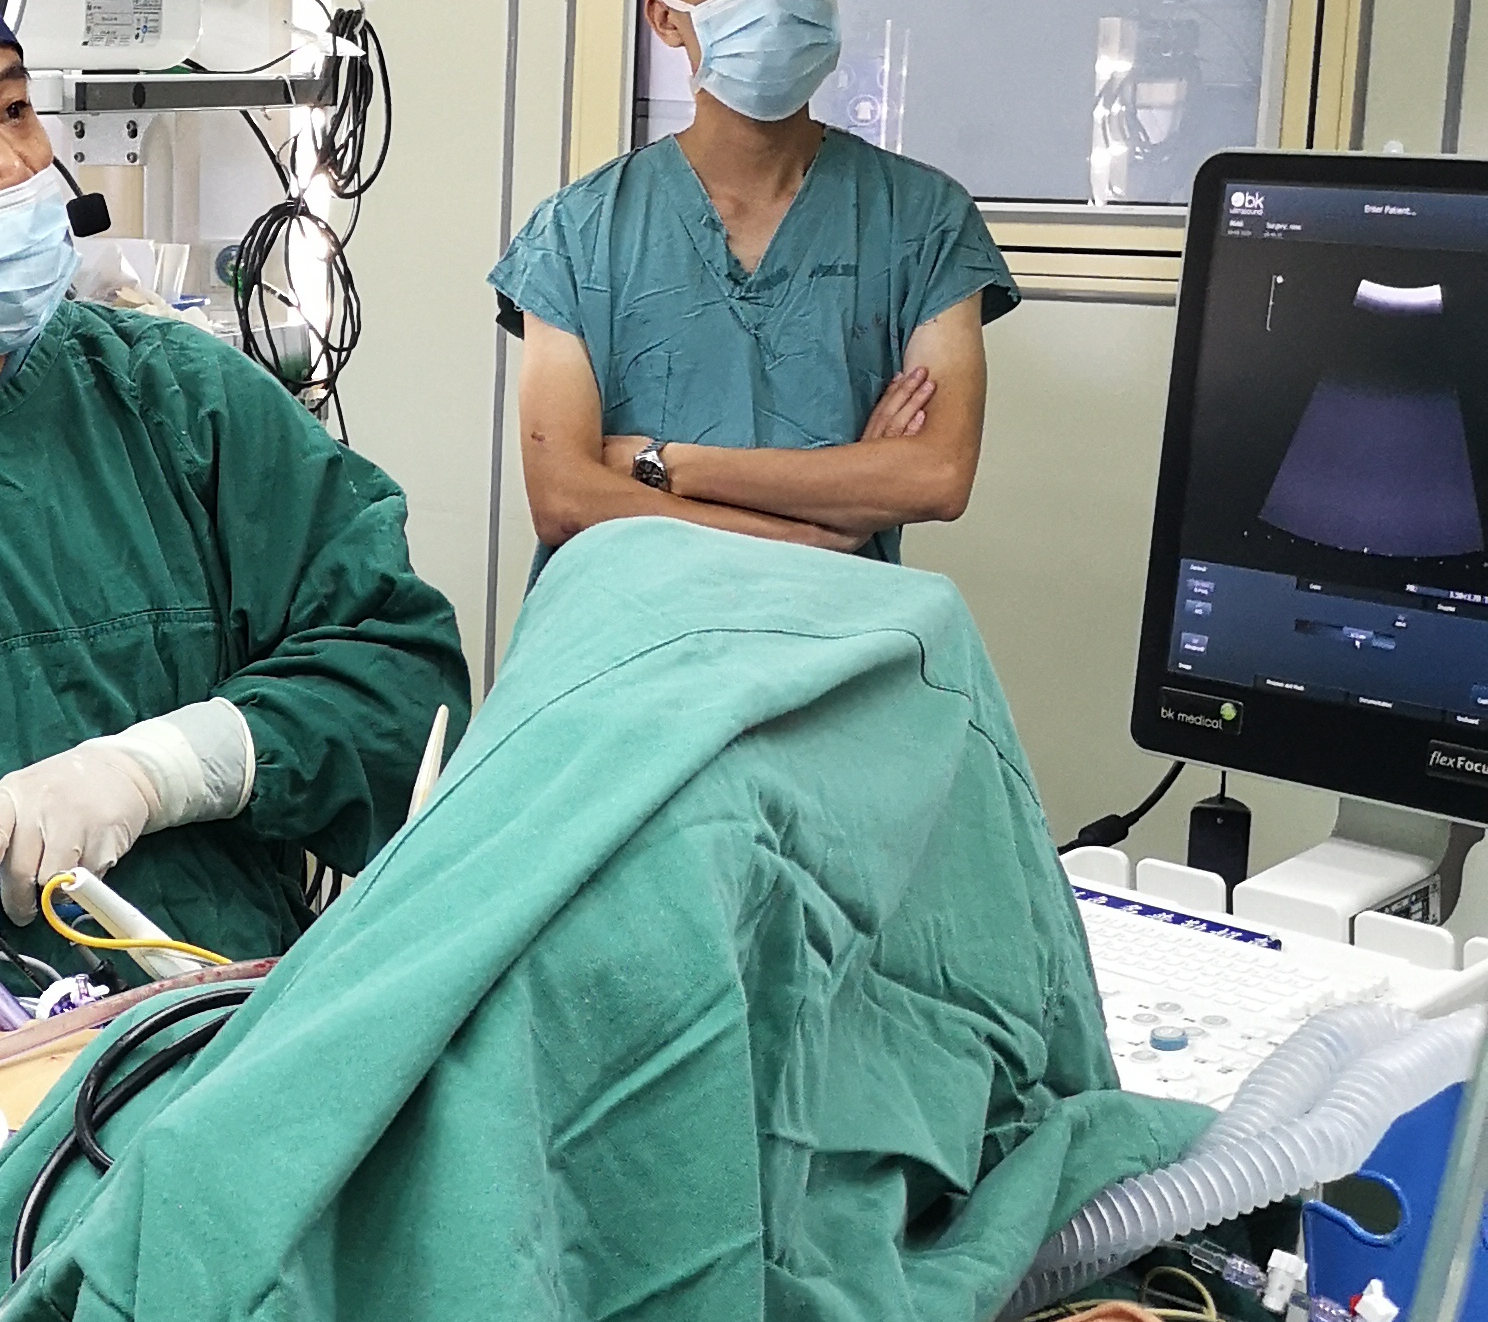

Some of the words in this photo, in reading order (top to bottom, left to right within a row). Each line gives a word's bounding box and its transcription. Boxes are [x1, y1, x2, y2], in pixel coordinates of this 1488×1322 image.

[1245, 191, 1265, 209] bk
[1160, 706, 1175, 720] bk
[1177, 712, 1223, 731] medical
